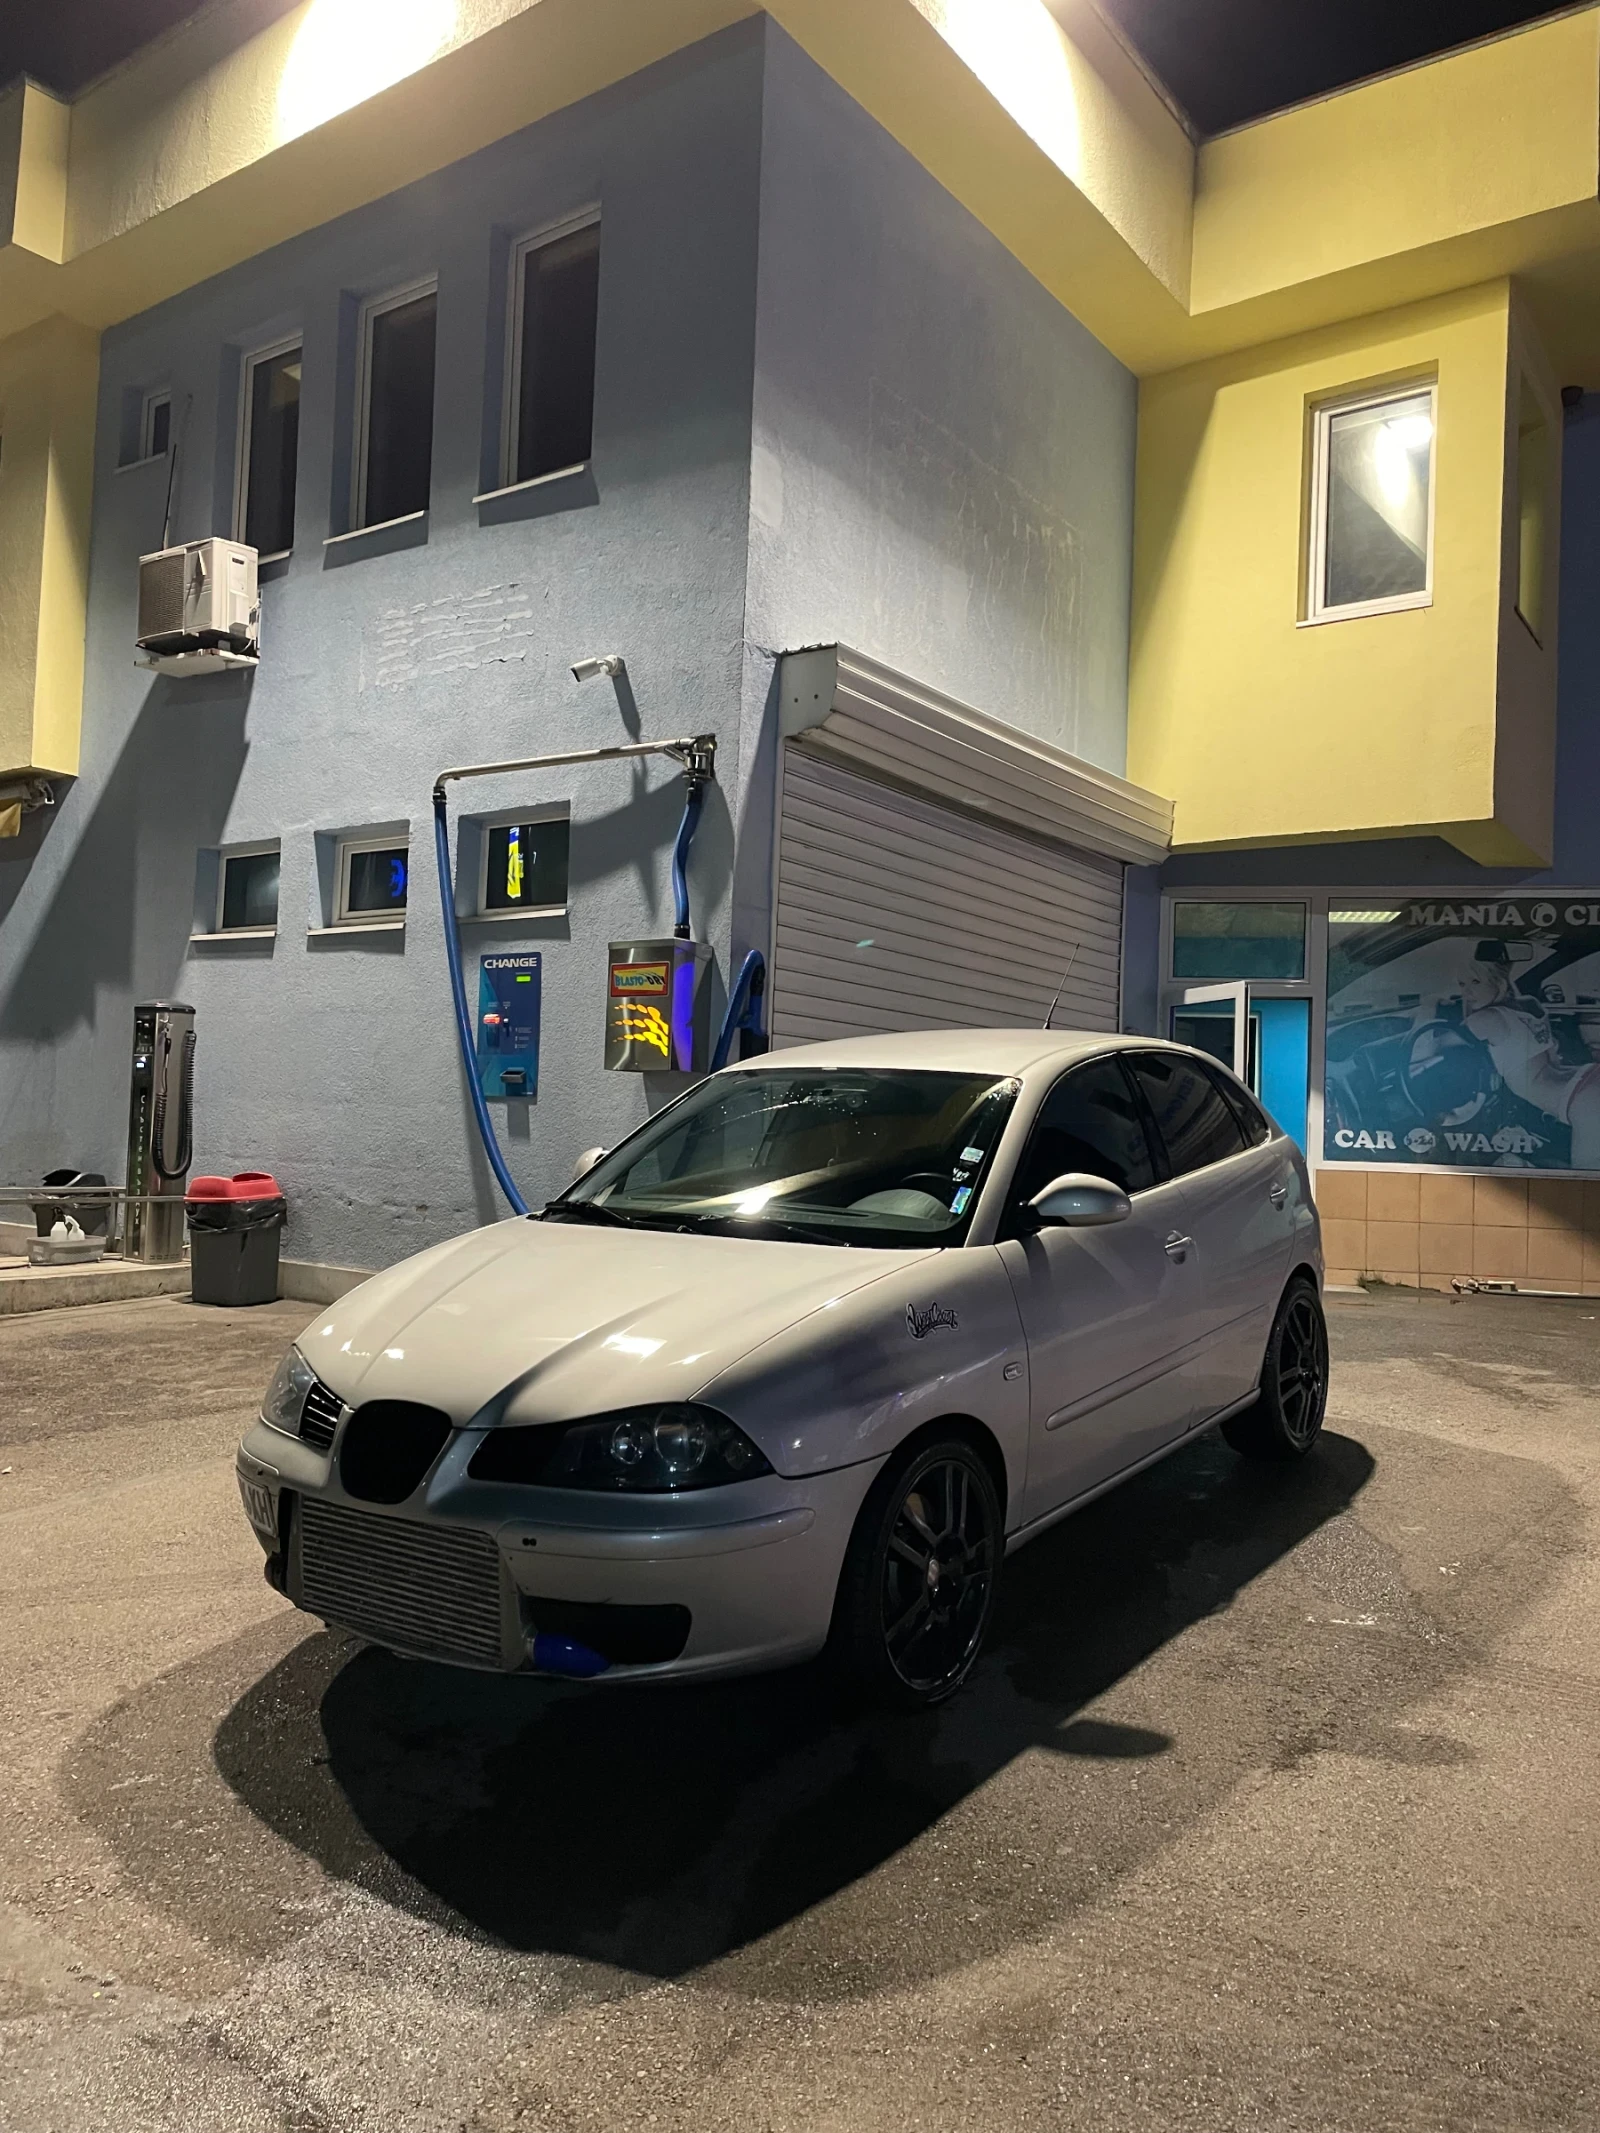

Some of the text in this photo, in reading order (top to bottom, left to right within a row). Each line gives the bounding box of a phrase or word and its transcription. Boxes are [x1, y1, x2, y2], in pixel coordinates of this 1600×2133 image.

[1409, 904, 1525, 926] MANIA
[484, 957, 538, 969] CHANGE
[1334, 1129, 1397, 1150] CAR
[1443, 1131, 1534, 1154] WASH
